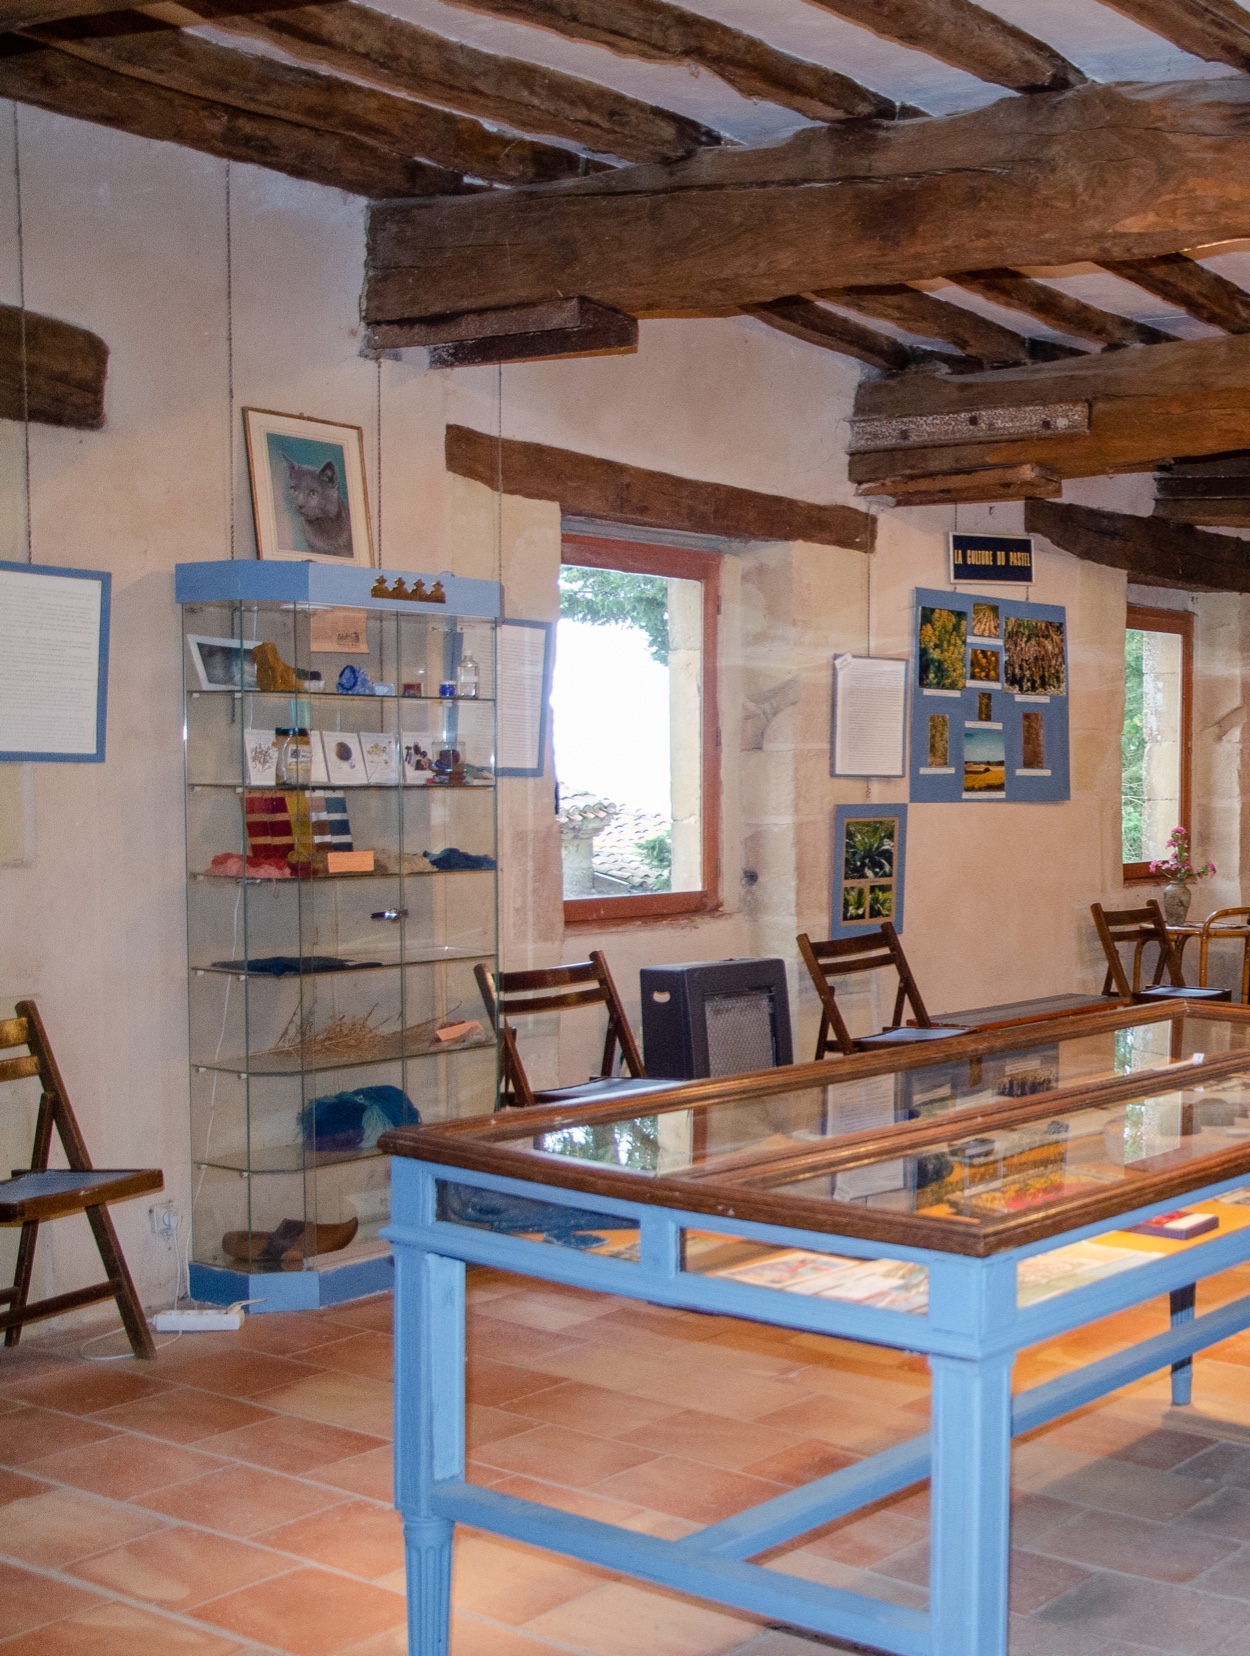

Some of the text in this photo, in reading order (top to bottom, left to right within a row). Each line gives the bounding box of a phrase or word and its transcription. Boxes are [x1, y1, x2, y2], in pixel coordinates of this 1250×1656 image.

[954, 550, 1031, 566] LA CULTURE DU PASTEL
